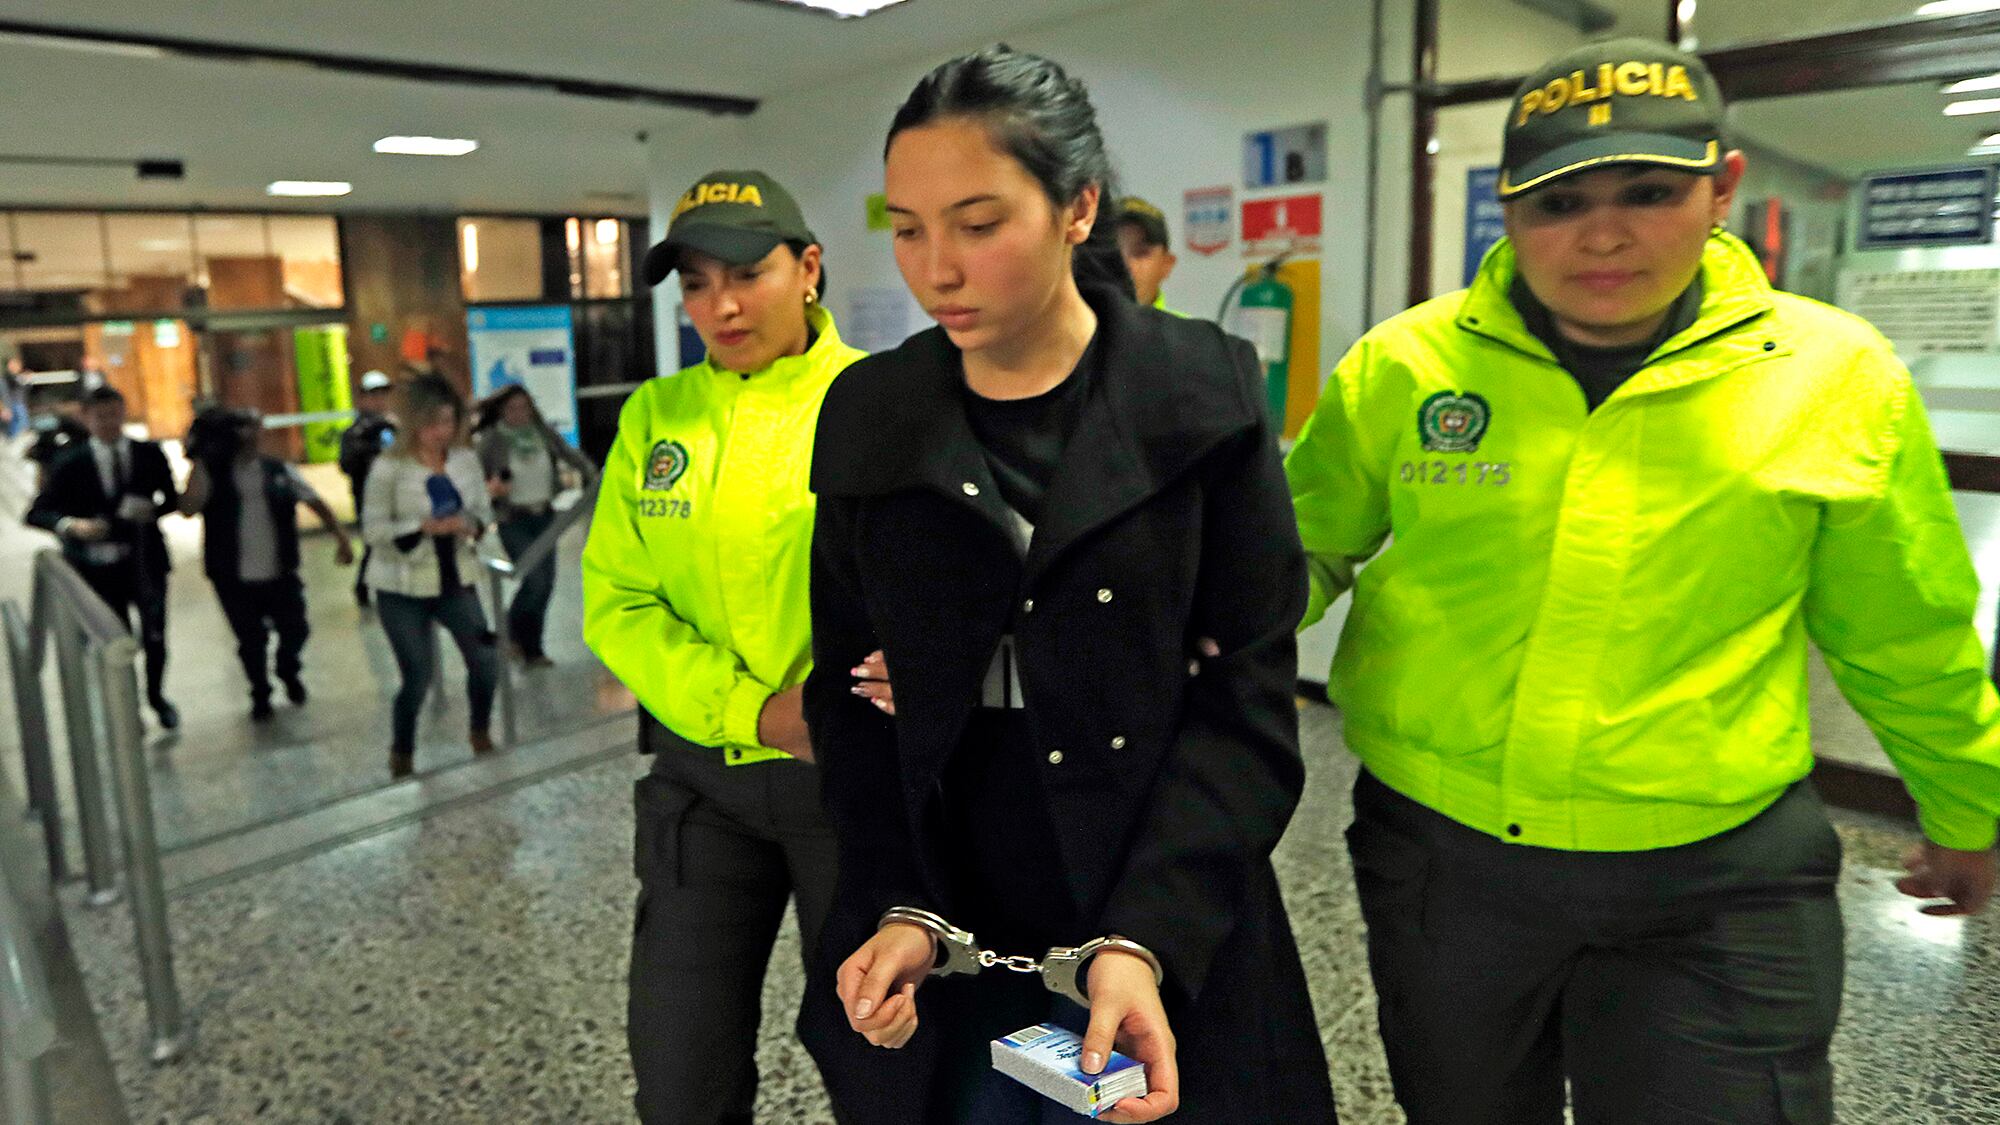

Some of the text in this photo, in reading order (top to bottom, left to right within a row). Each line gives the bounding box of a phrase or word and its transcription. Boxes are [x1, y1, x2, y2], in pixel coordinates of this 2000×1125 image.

[1515, 60, 1698, 127] POLICIA
[670, 182, 763, 221] LICIA
[1400, 460, 1512, 486] 012175
